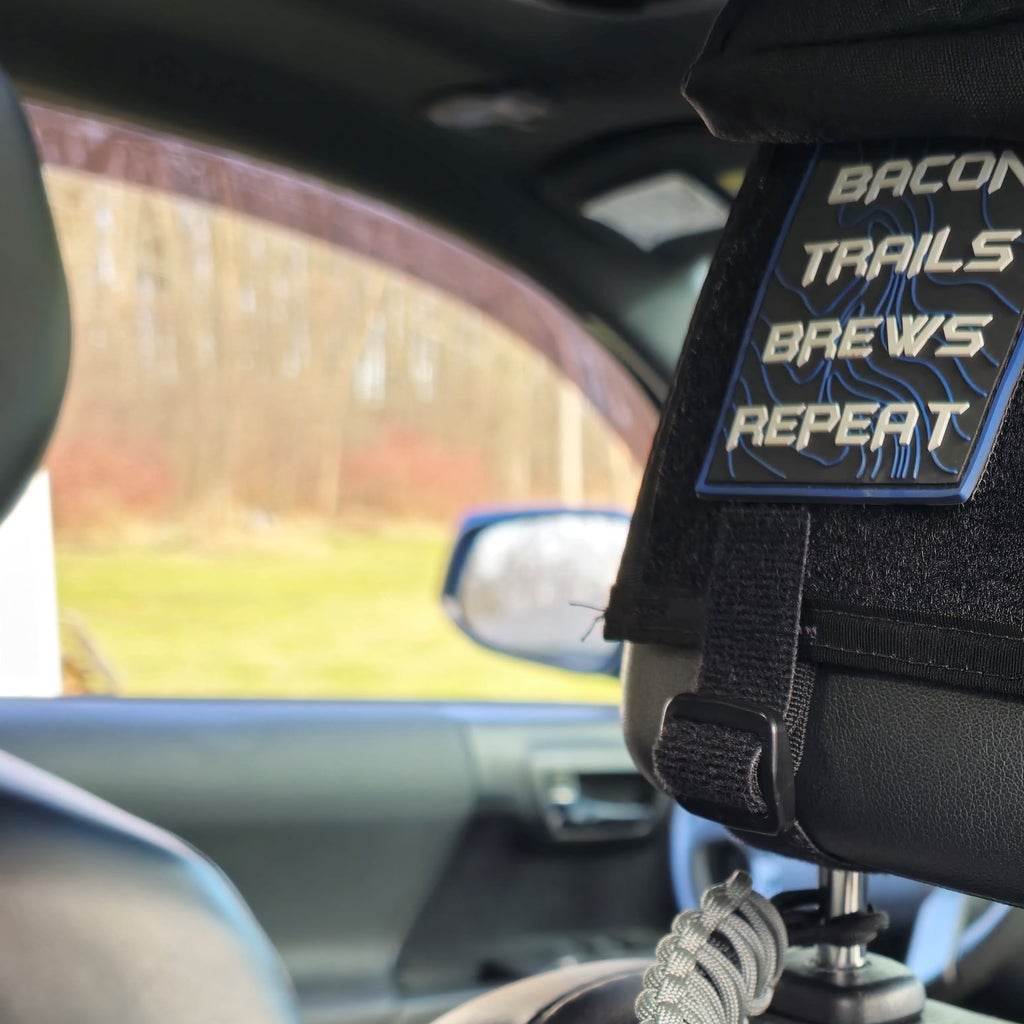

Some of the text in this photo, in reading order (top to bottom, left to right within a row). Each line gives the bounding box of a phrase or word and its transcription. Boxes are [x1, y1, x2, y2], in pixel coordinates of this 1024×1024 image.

[802, 226, 1022, 287] TRAILS
[762, 314, 993, 367] BREWS
[726, 402, 970, 452] REPEAT
